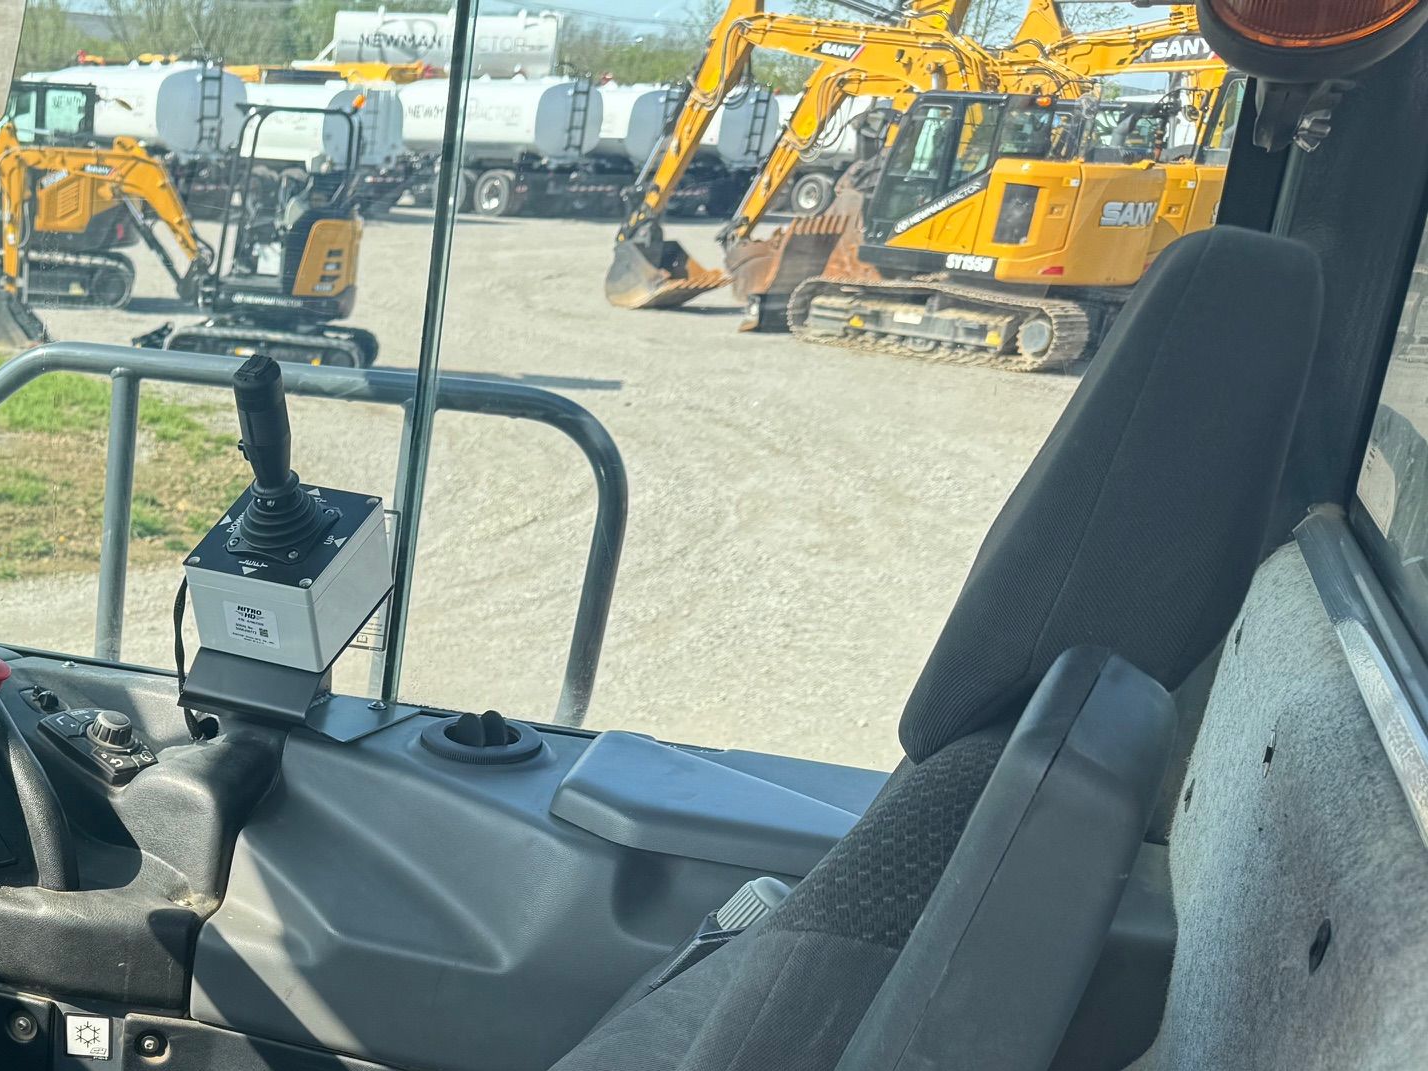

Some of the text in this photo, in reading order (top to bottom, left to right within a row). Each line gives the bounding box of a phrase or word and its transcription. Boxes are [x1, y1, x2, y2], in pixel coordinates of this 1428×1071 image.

[1100, 201, 1158, 227] SANY
[324, 535, 335, 545] UP
[237, 605, 262, 616] NITRO
[244, 612, 257, 620] HD
